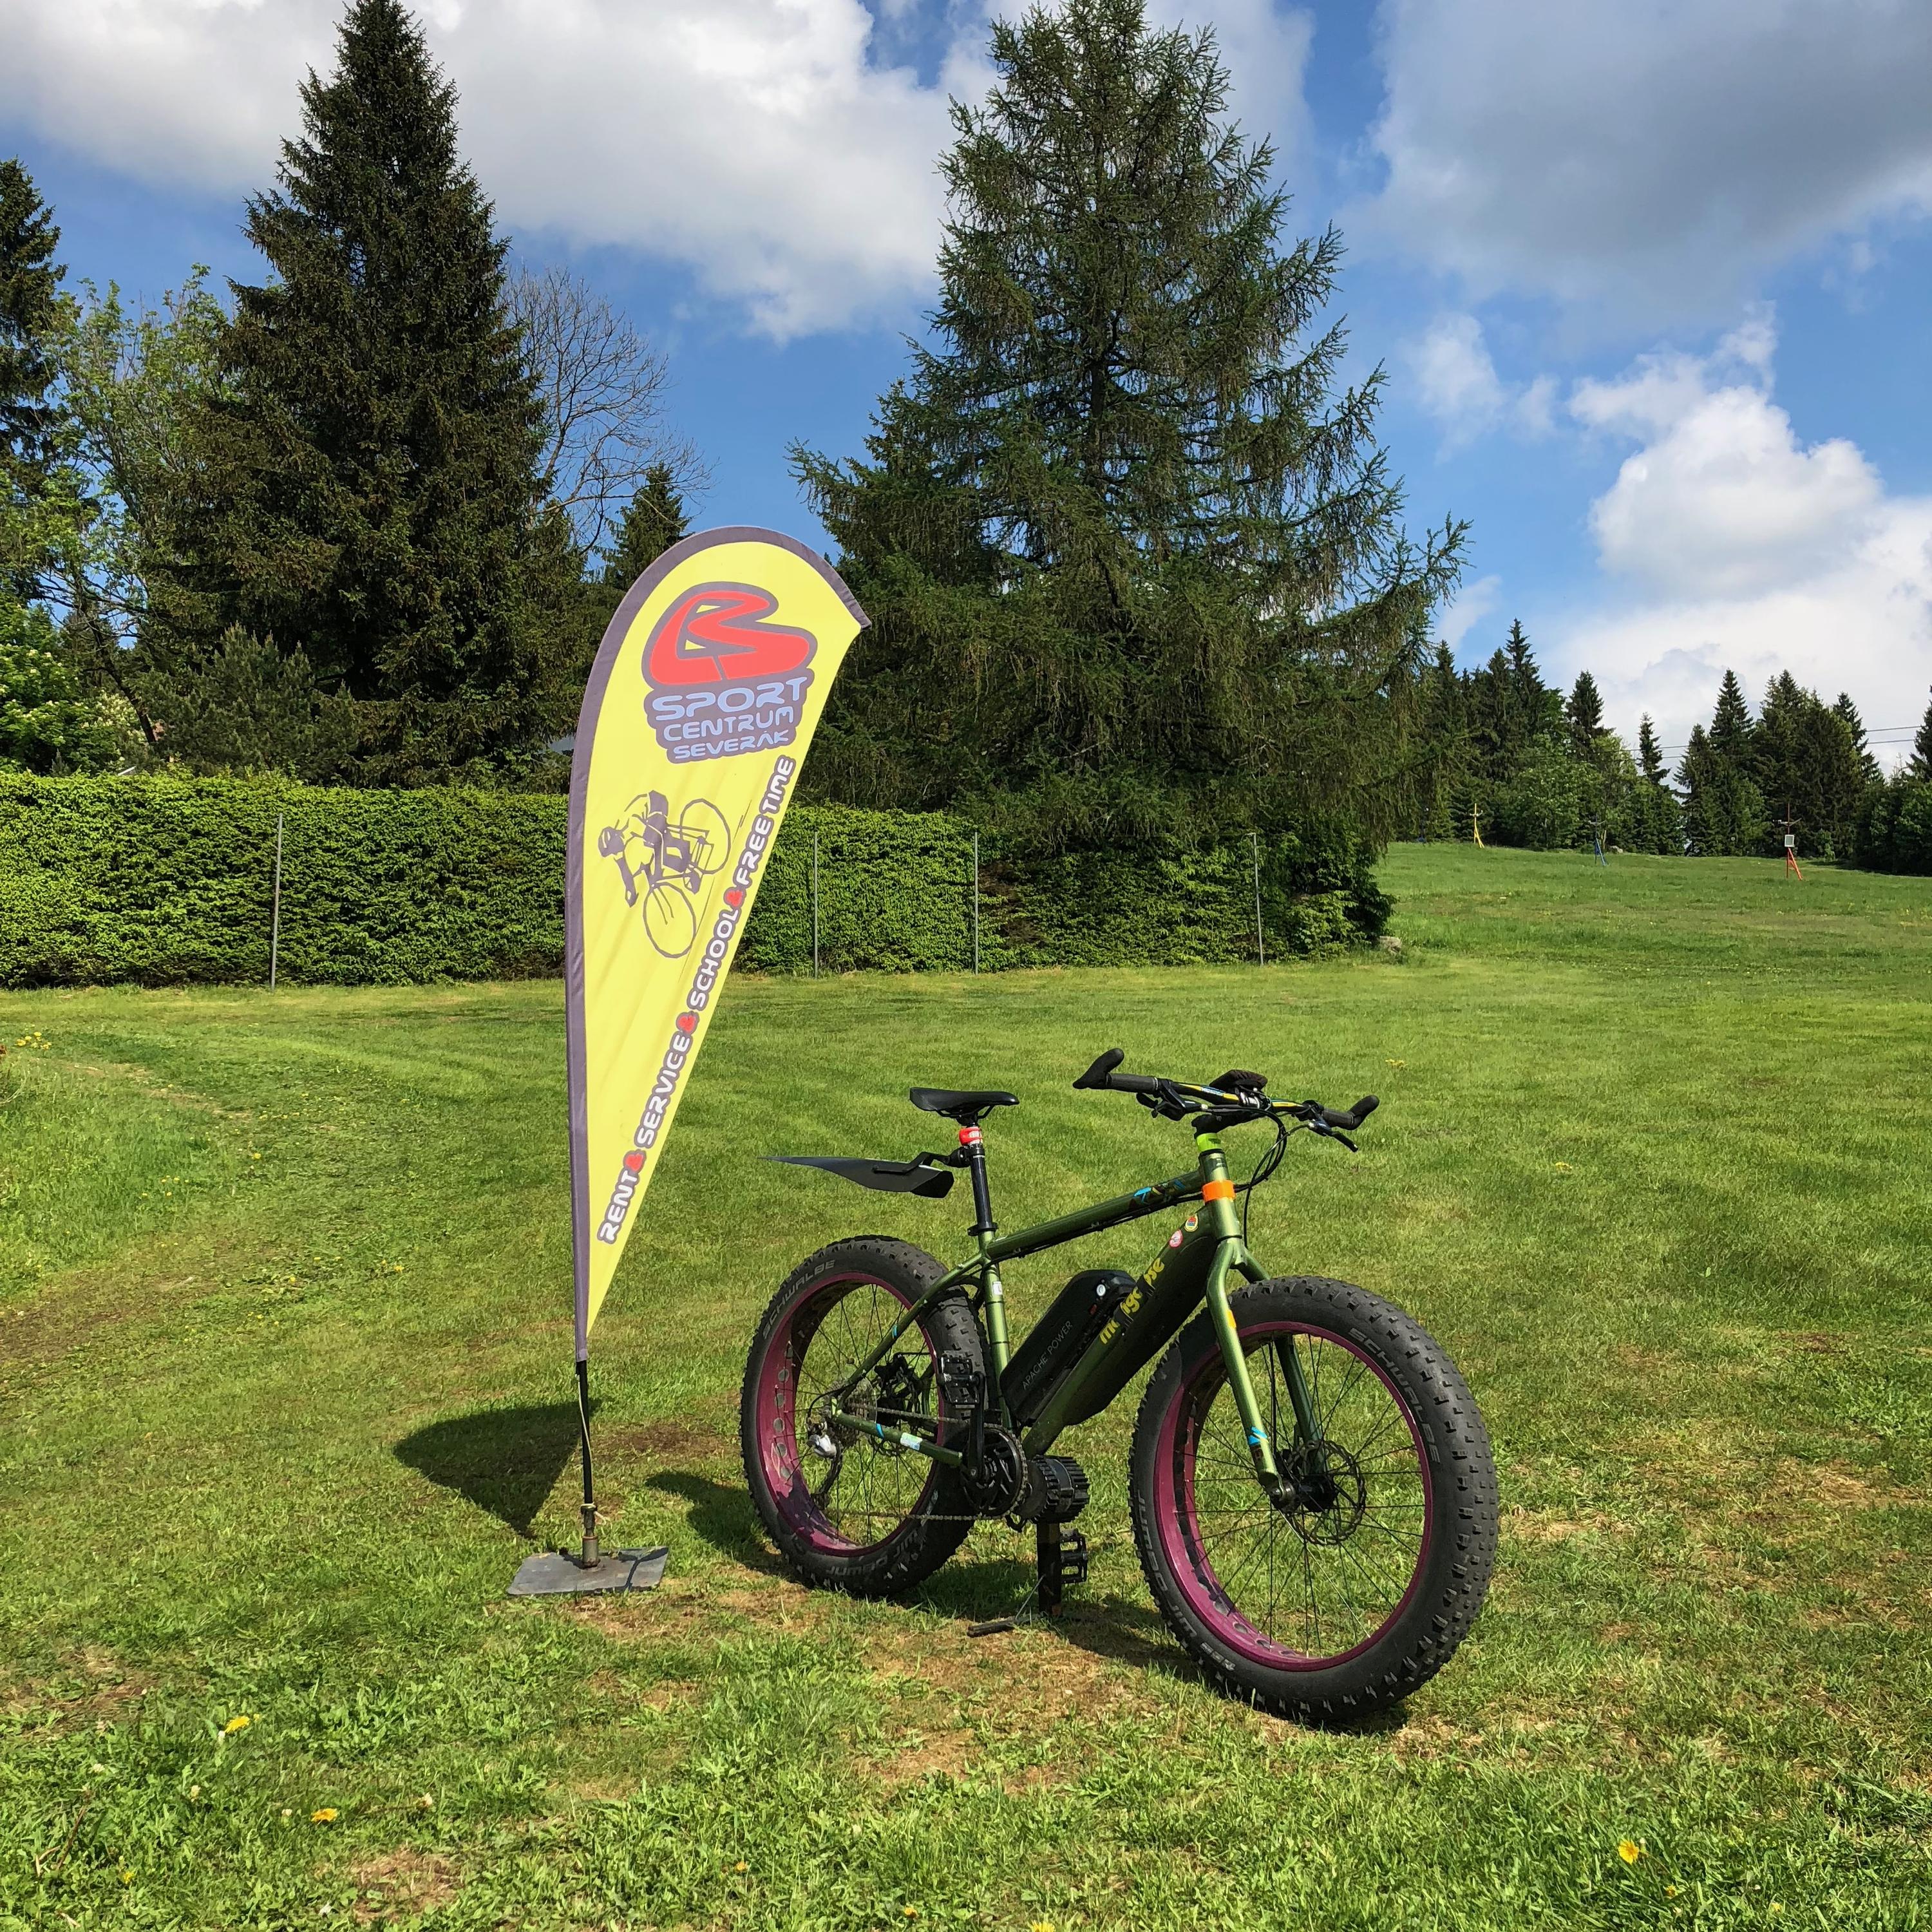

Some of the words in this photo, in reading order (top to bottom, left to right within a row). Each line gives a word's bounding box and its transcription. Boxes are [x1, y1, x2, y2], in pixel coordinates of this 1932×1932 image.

[652, 676, 808, 721] SPORT
[663, 706, 794, 742] CENTRUM
[673, 729, 789, 759] SEVERÁK
[600, 1170, 638, 1241] RENT
[636, 1034, 690, 1146] SERVICE
[690, 909, 739, 1009] SCHOOL
[735, 817, 772, 886] FREE
[762, 758, 793, 811] TIME
[762, 1259, 835, 1340] SCHWALBE
[1022, 1353, 1048, 1390] APACHE
[1047, 1320, 1073, 1355] POWER
[1348, 1327, 1441, 1464] SCHWALBE
